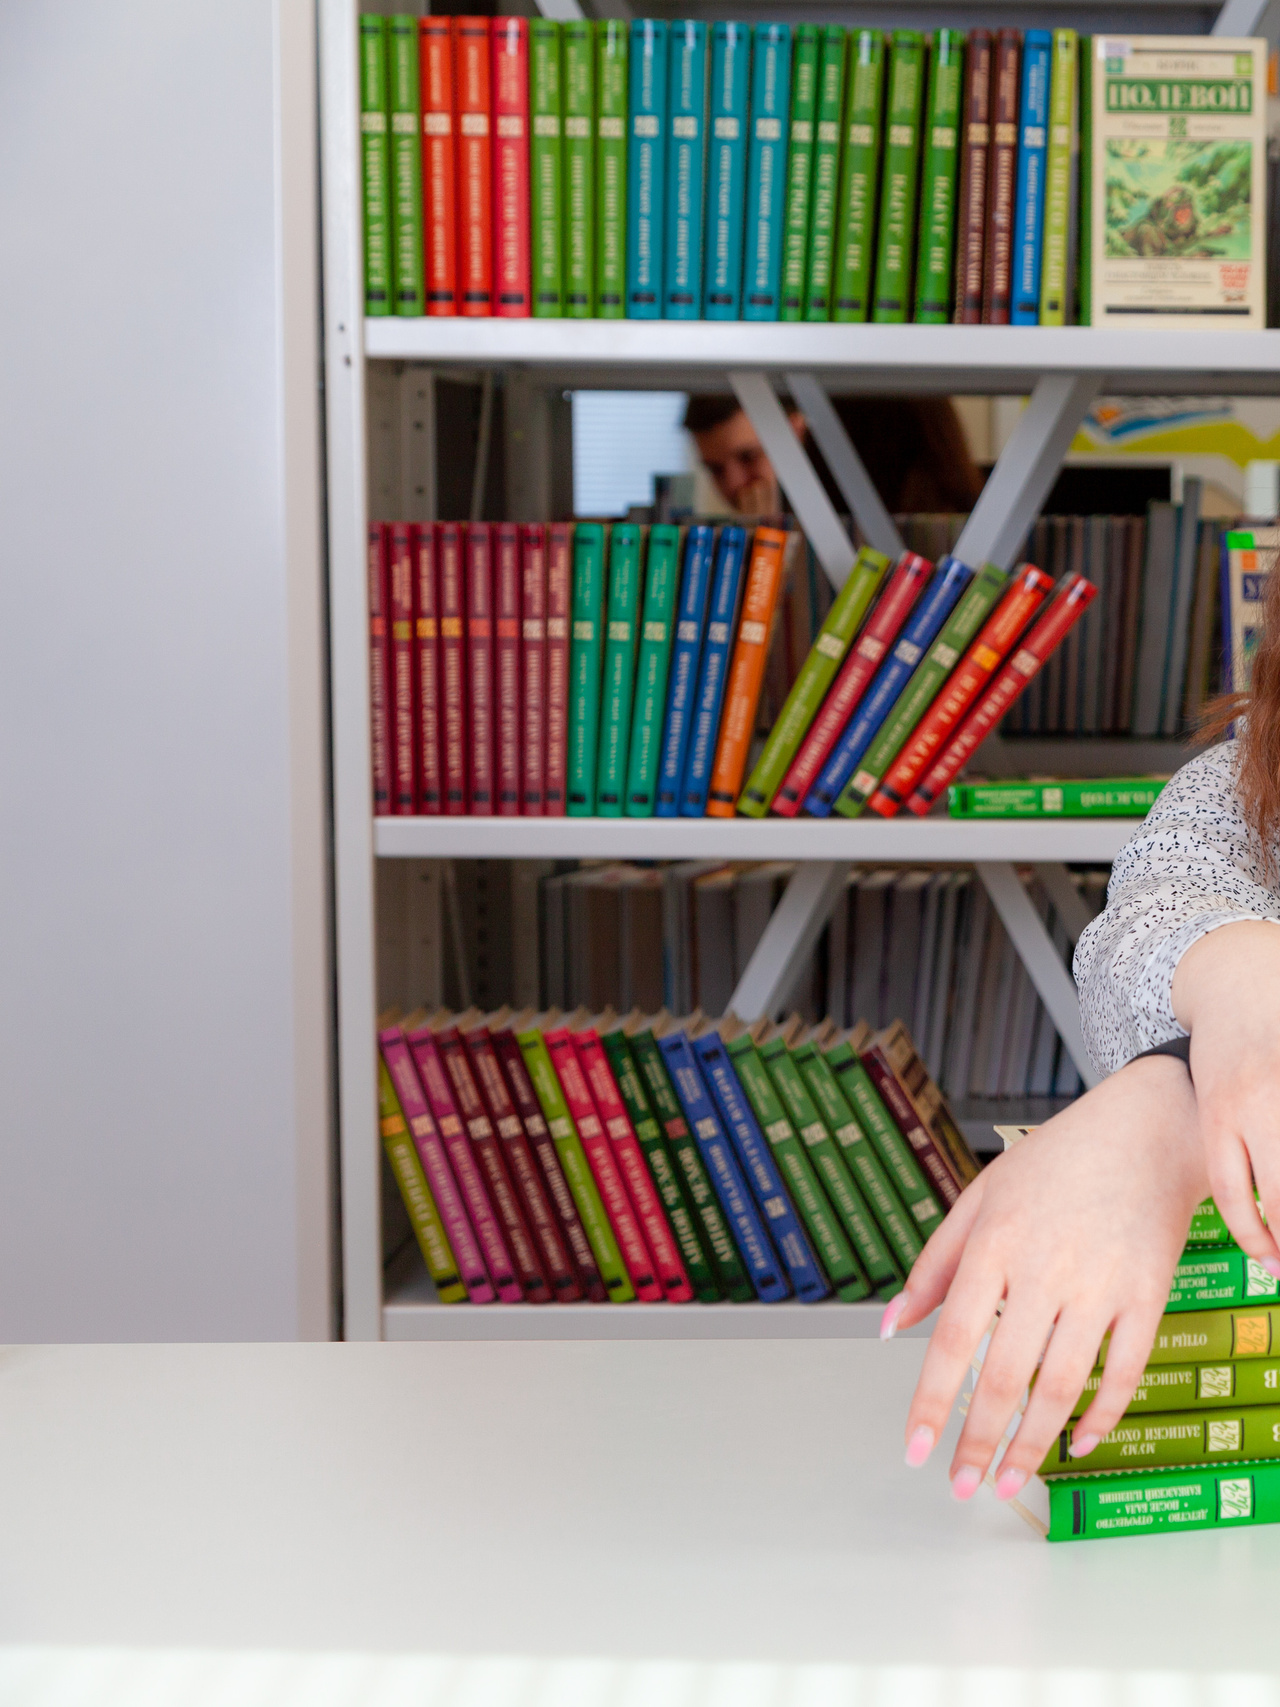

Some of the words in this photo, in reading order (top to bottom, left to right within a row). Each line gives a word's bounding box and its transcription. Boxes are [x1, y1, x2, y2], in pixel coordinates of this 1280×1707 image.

[1107, 79, 1251, 110] ПОЛЕВОЙ
[649, 1147, 679, 1206] ЧЕХОВ
[678, 1146, 710, 1205] ЧЕХОВ
[1196, 1286, 1236, 1299] ДЕТСТВО
[1159, 1336, 1168, 1349] И
[1171, 1333, 1208, 1350] ОТЦЫ
[1144, 1424, 1201, 1440] ЗАПИСКИ
[1119, 1442, 1156, 1456] МУМУ
[1098, 1487, 1142, 1504] ПЛЕННИК
[1142, 1484, 1202, 1502] КАВКАЗСКИЙ
[1124, 1501, 1149, 1514] БАЛА
[1155, 1499, 1180, 1514] ПОСЛЕ
[1096, 1514, 1154, 1530] ОТРОЧЕСТВО
[1168, 1508, 1209, 1523] ДЕТСТВО
